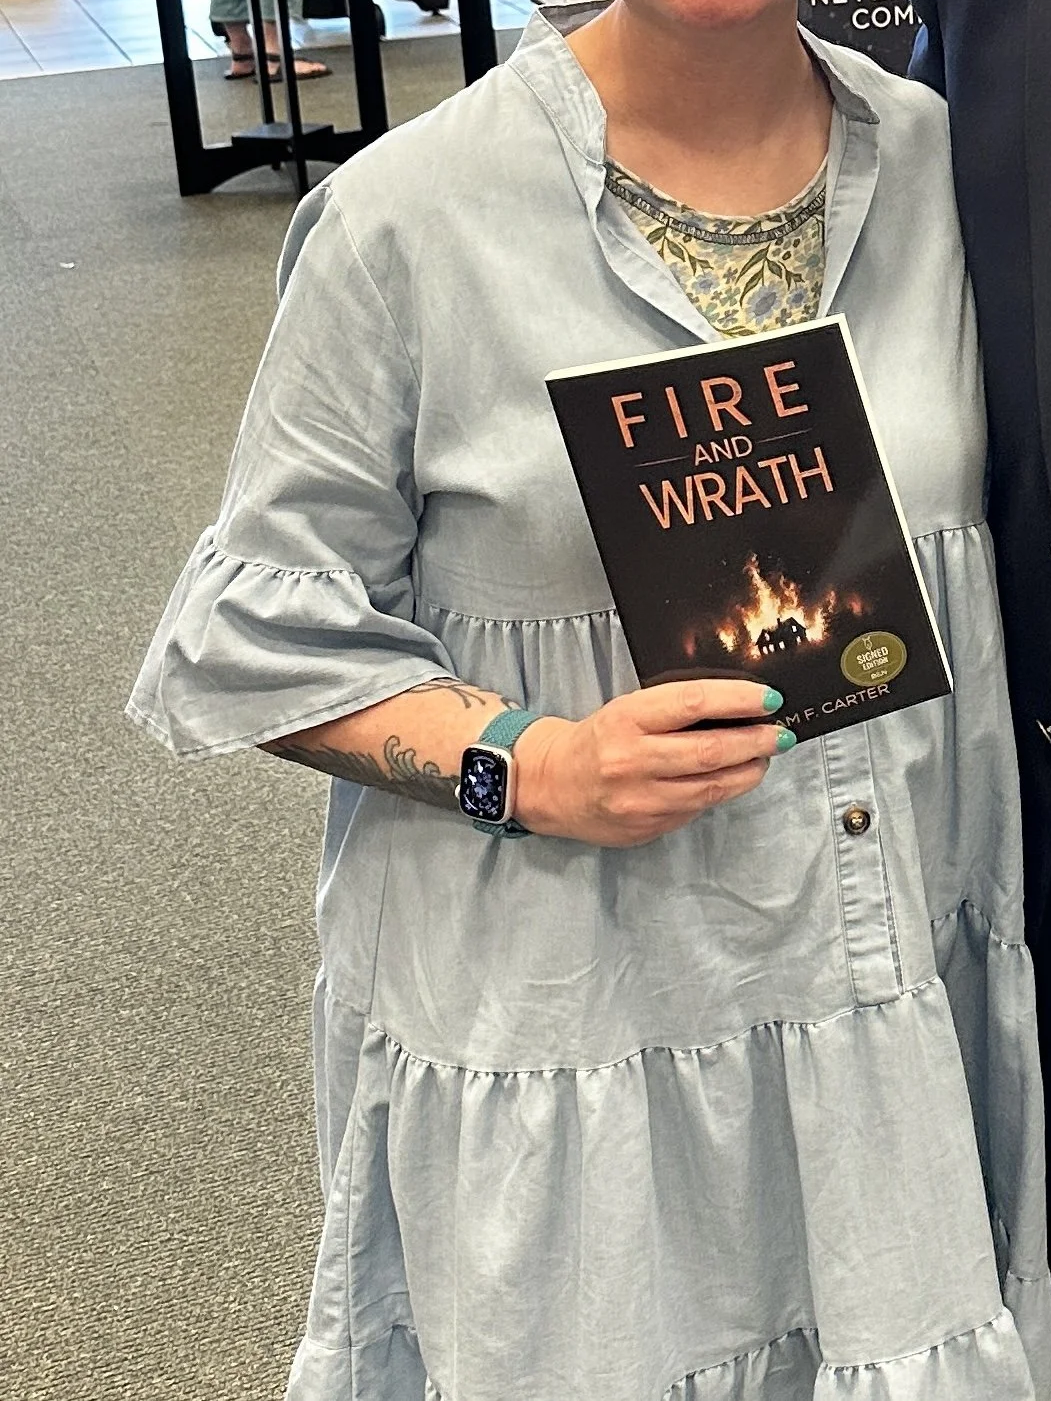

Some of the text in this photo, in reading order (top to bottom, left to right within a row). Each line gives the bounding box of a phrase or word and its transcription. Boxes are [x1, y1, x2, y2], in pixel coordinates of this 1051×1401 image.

[611, 361, 809, 448] FIRE
[694, 435, 753, 467] AND
[639, 446, 834, 529] WRATH
[856, 646, 889, 666] SIGNED
[862, 656, 889, 672] EDITION
[775, 683, 891, 729] AM F. CARTER
